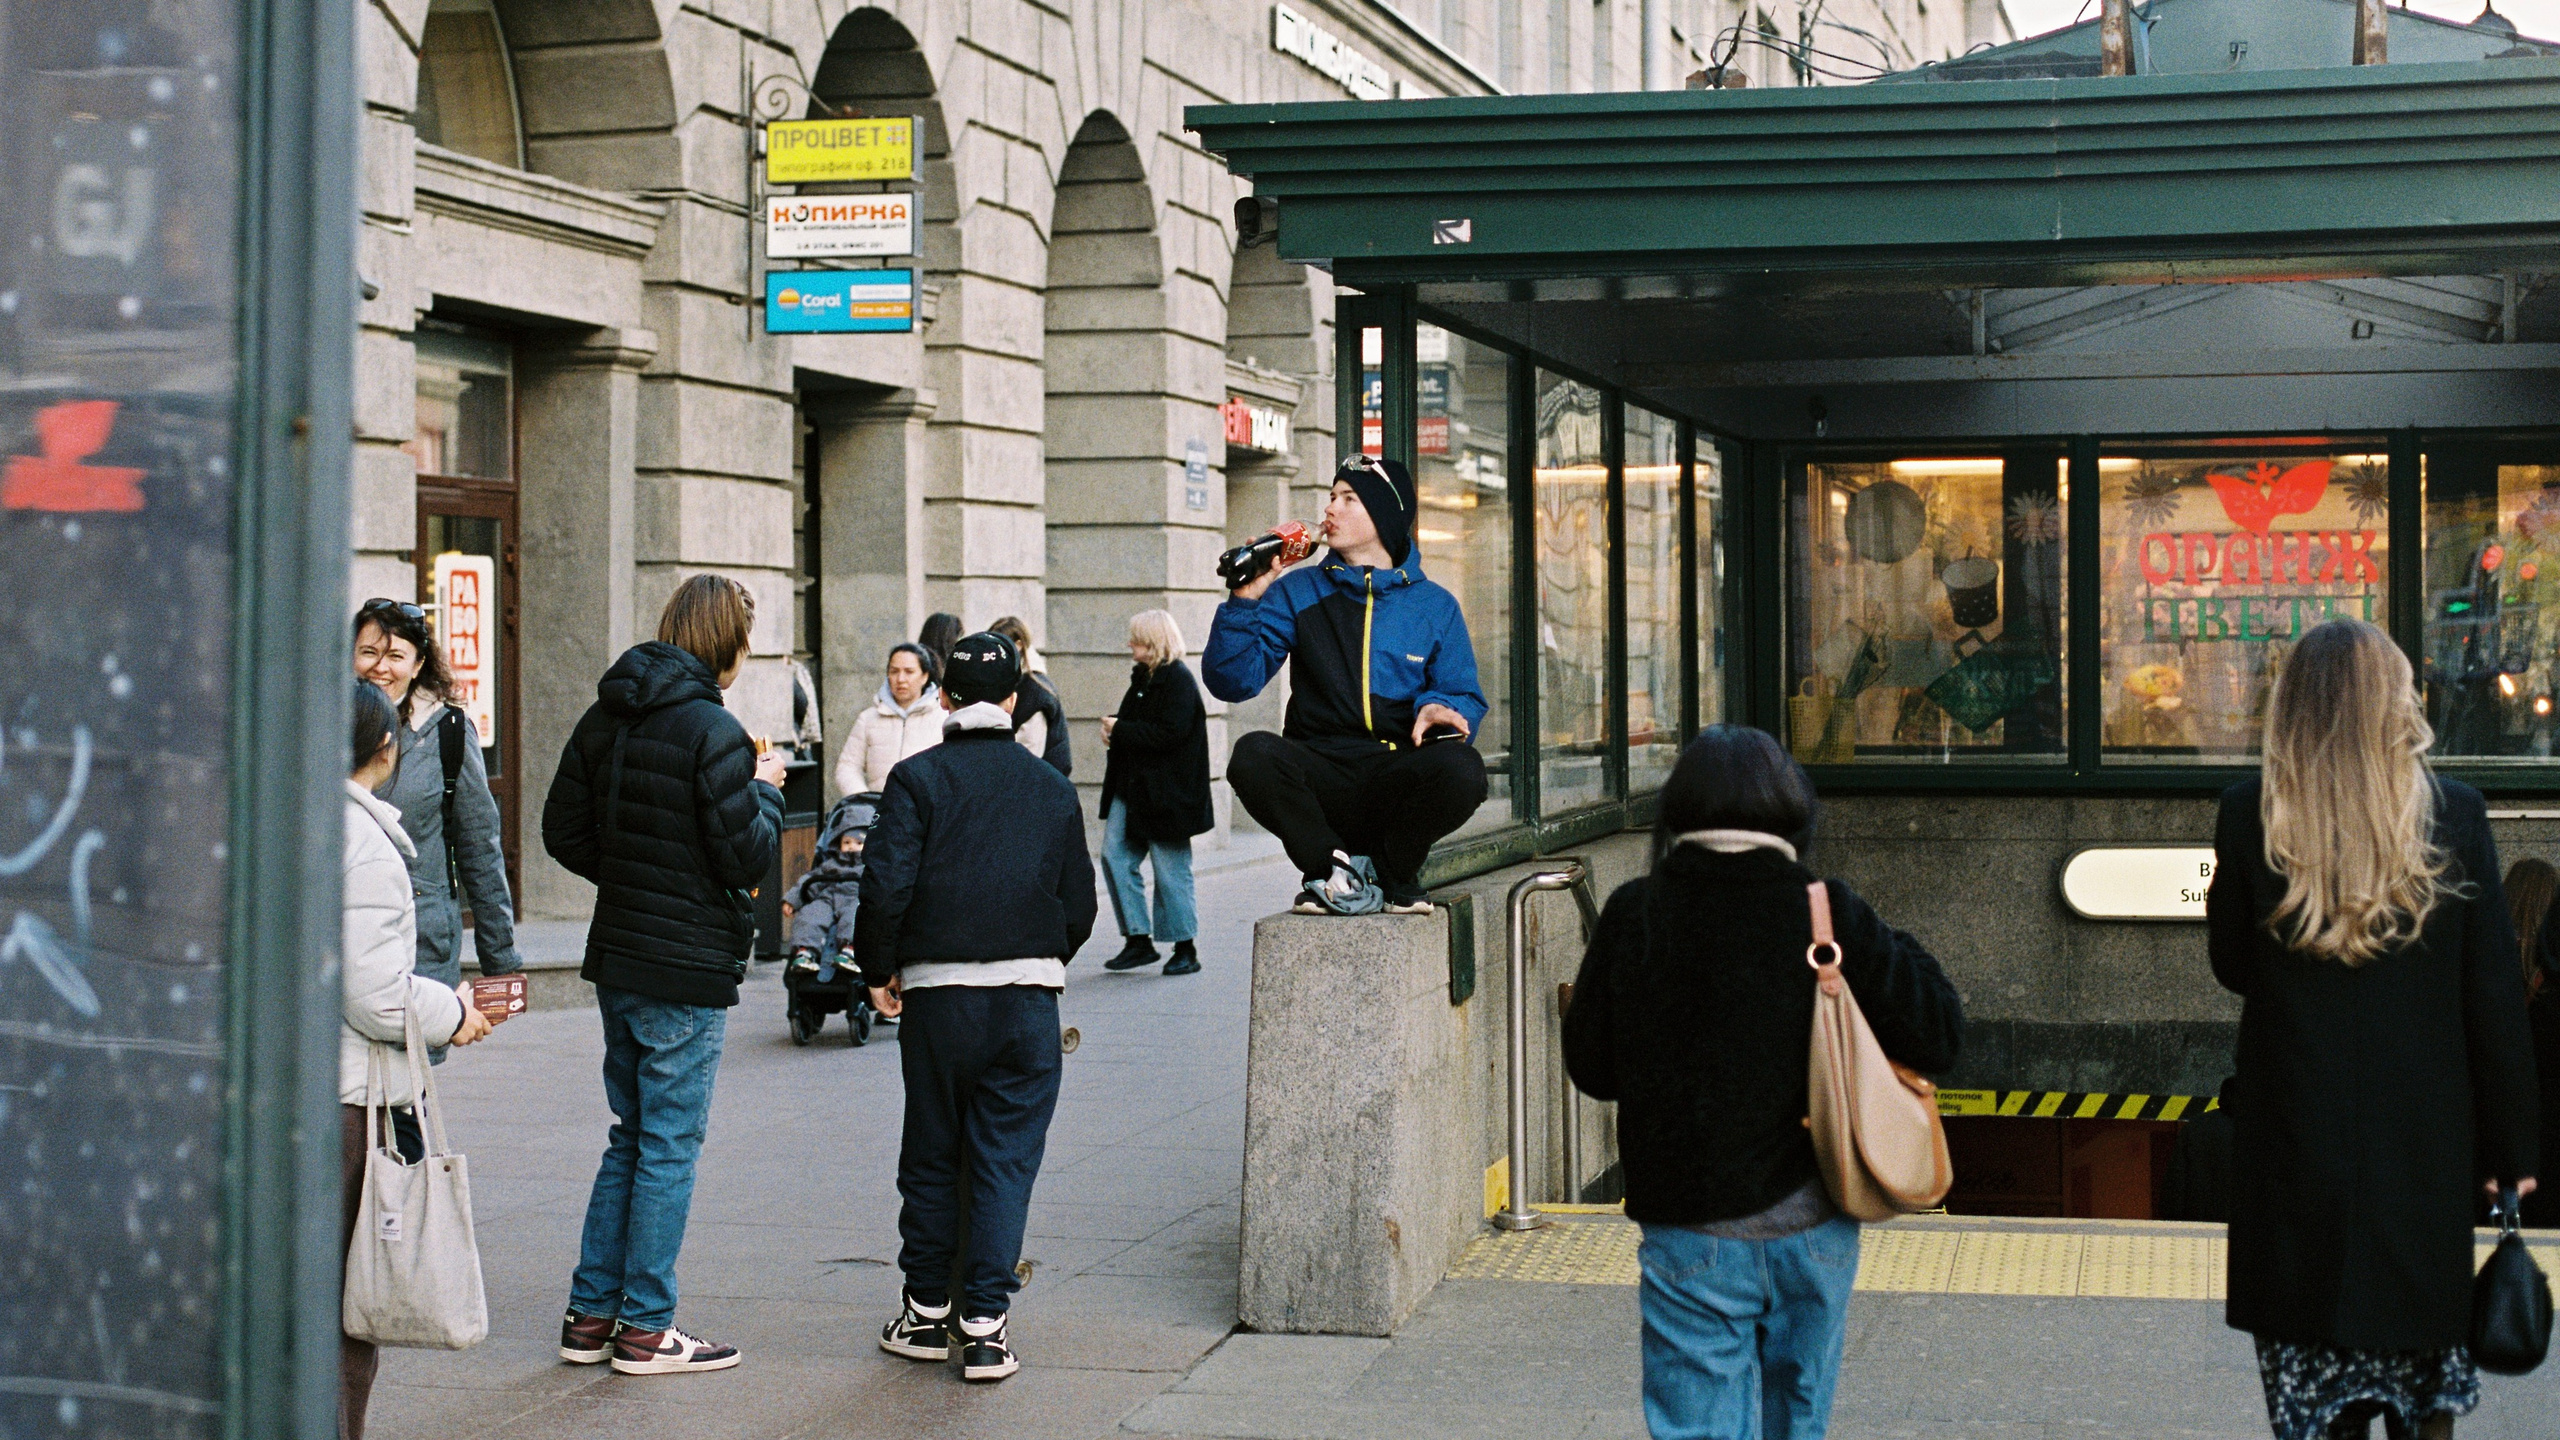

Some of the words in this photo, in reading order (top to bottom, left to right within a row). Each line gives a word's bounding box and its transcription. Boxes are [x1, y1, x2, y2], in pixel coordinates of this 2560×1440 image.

[773, 126, 882, 150] ПРОЦВЕТ
[802, 292, 842, 308] Coral
[2139, 530, 2379, 587] ОРАНЖ
